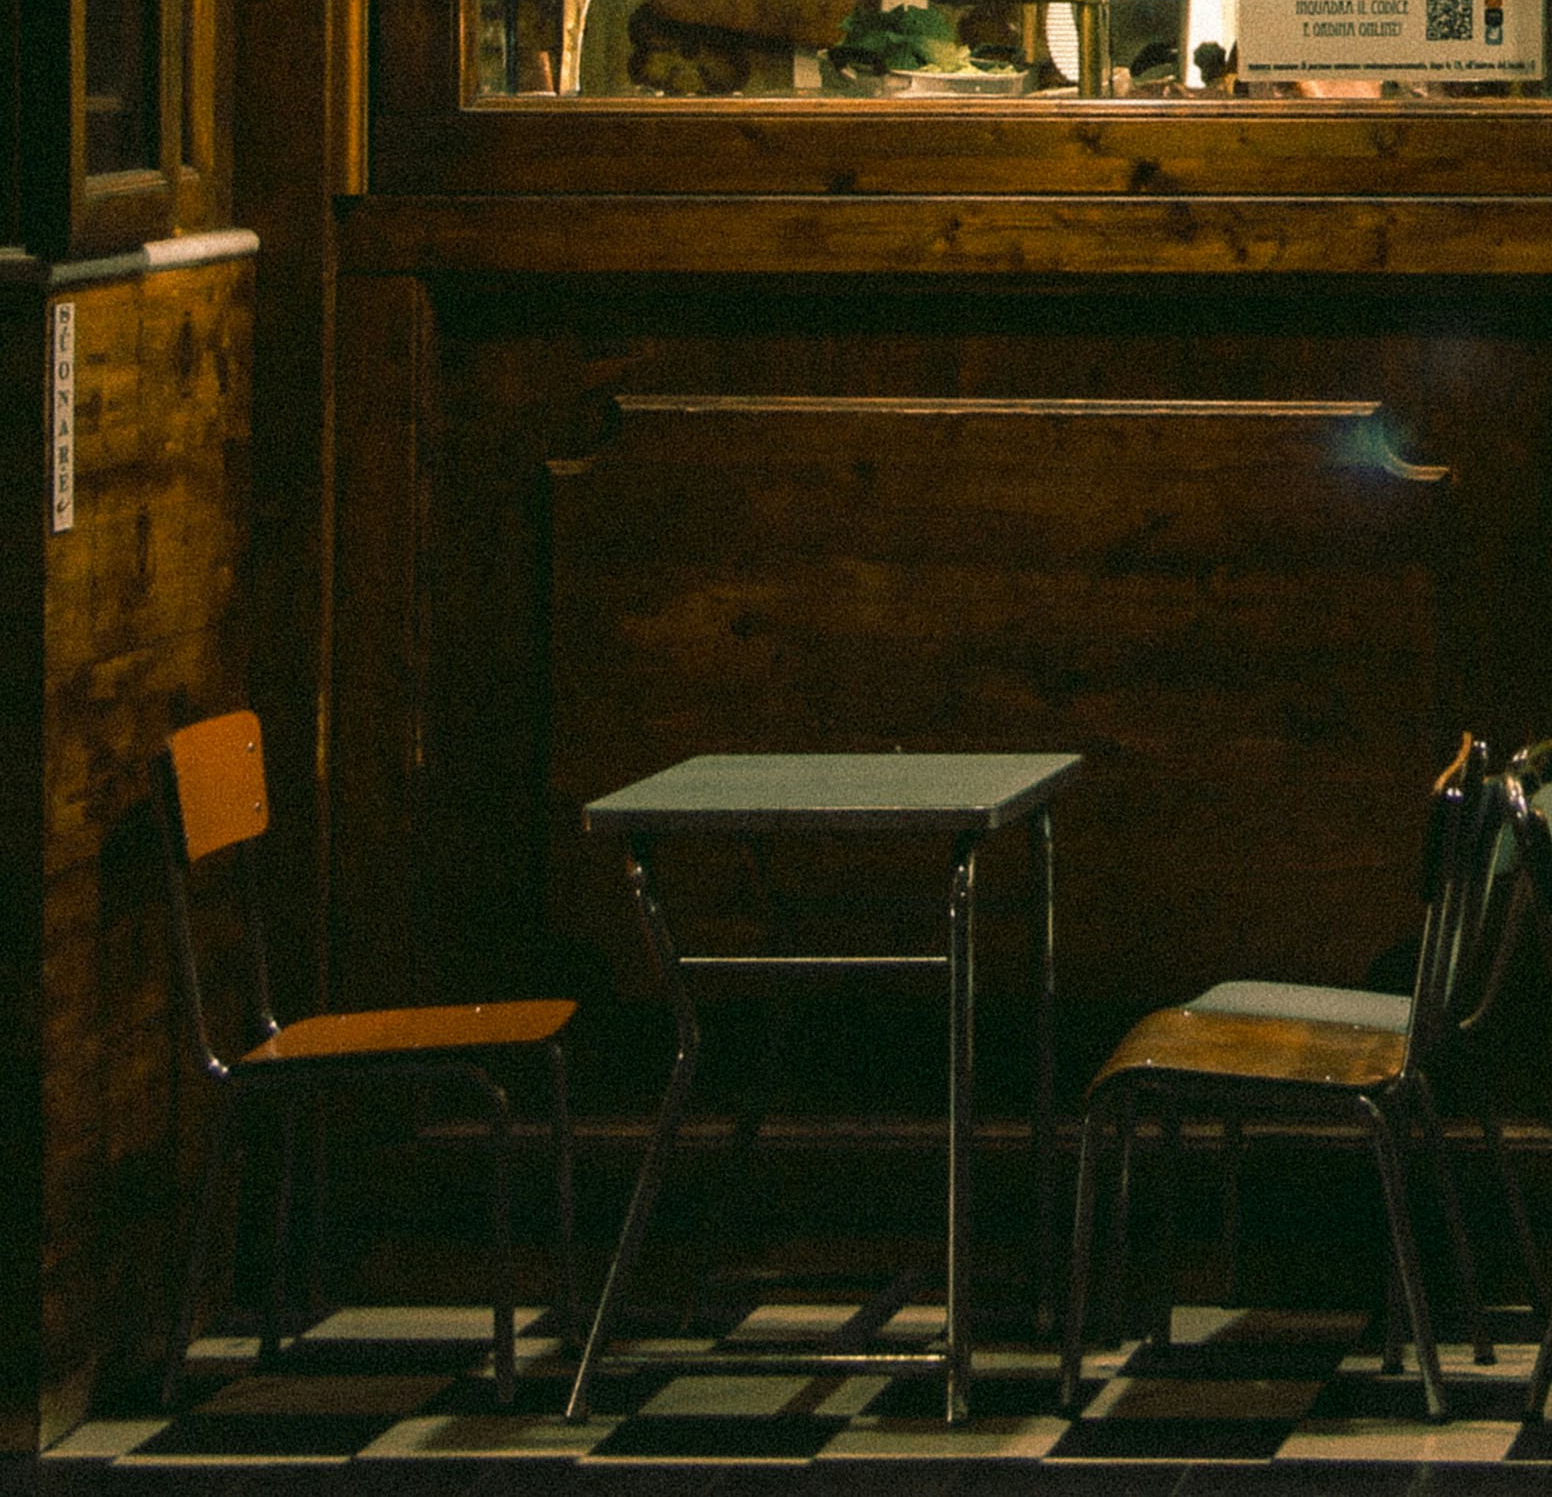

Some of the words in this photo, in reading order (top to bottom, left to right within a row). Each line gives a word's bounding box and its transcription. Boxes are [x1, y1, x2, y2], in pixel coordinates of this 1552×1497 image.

[1296, 0, 1353, 16] INQUADRA
[1357, 0, 1367, 15] IL
[1370, 0, 1409, 15] CODICE
